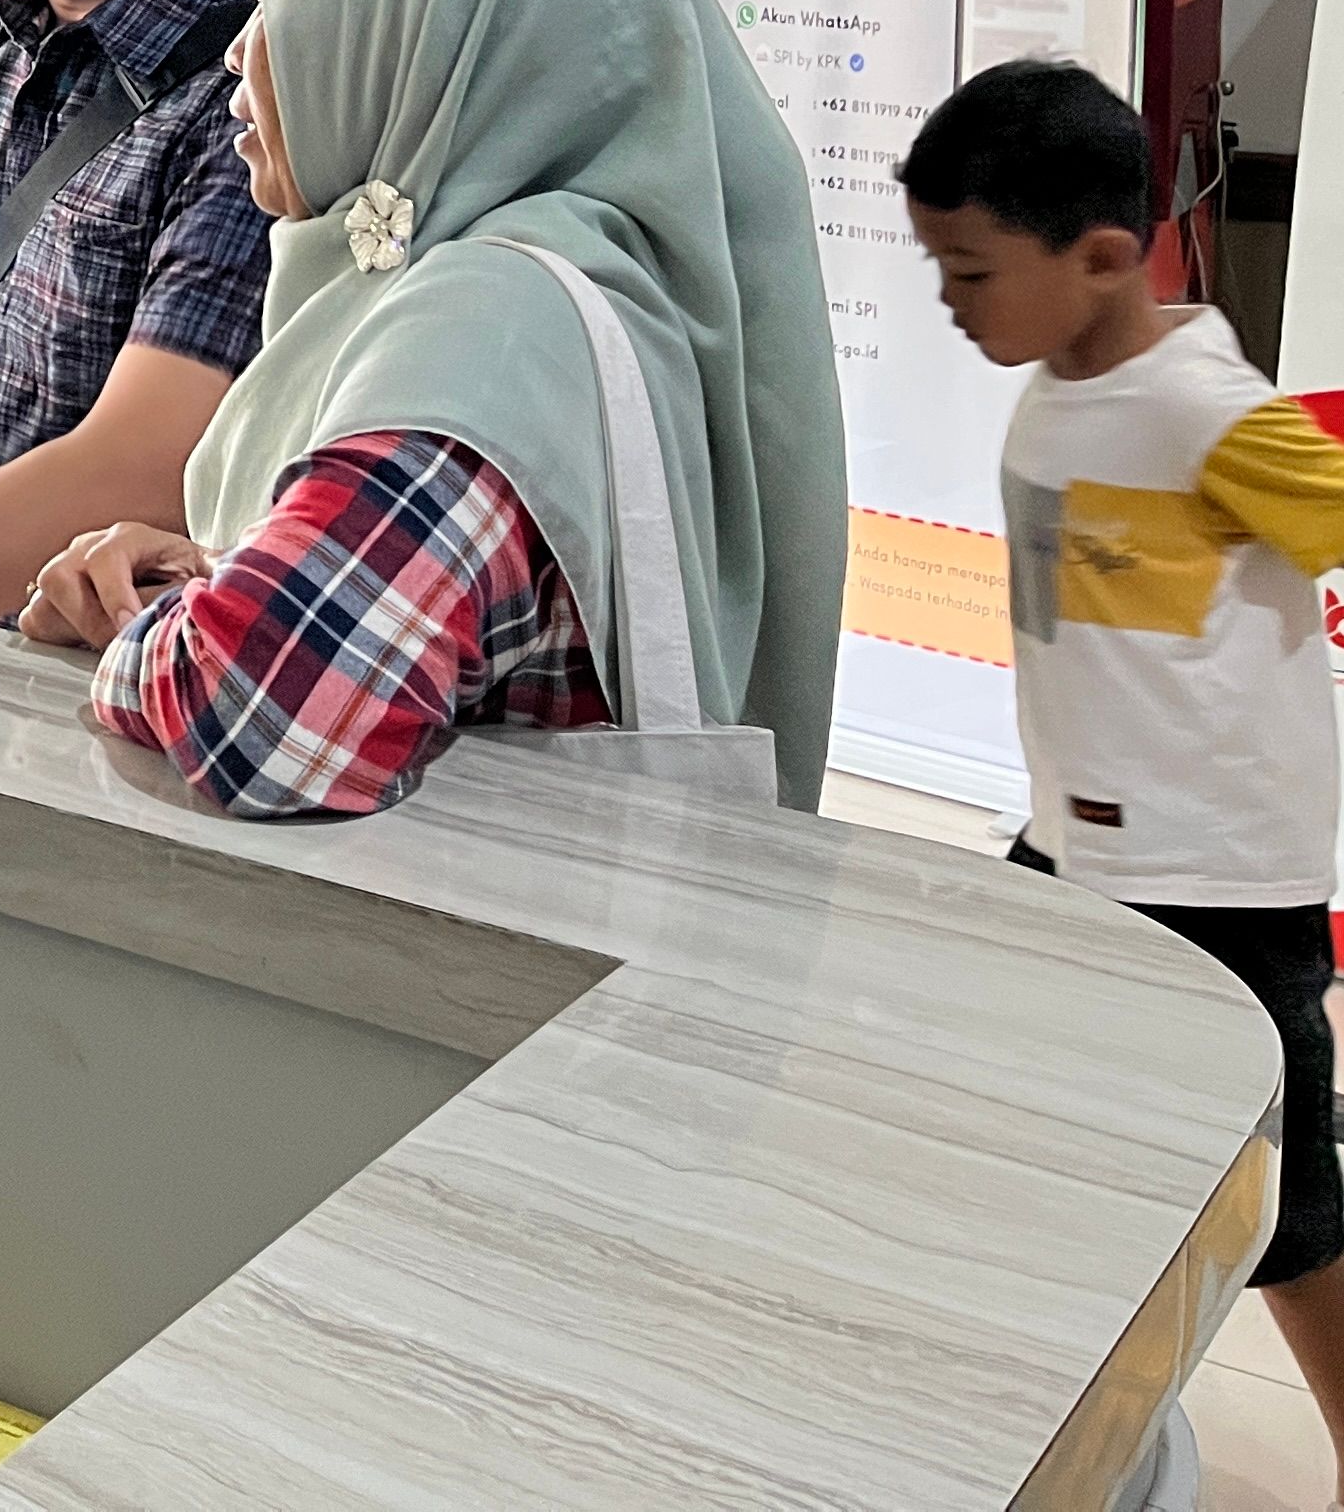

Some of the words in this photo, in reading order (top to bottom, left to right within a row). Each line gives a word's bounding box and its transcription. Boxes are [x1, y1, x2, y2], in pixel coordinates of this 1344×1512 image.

[760, 7, 796, 25] Akun
[800, 10, 881, 35] WhatsApp
[774, 49, 793, 65] SPI
[797, 51, 813, 71] by
[817, 54, 842, 69] KPK
[822, 98, 847, 112] +62
[821, 146, 846, 159] +62
[820, 176, 845, 190] +62
[819, 222, 844, 236] +62
[855, 301, 878, 319] SPI
[854, 544, 889, 563] Anda
[859, 575, 922, 601] Waspada
[927, 591, 991, 618] terhadap
